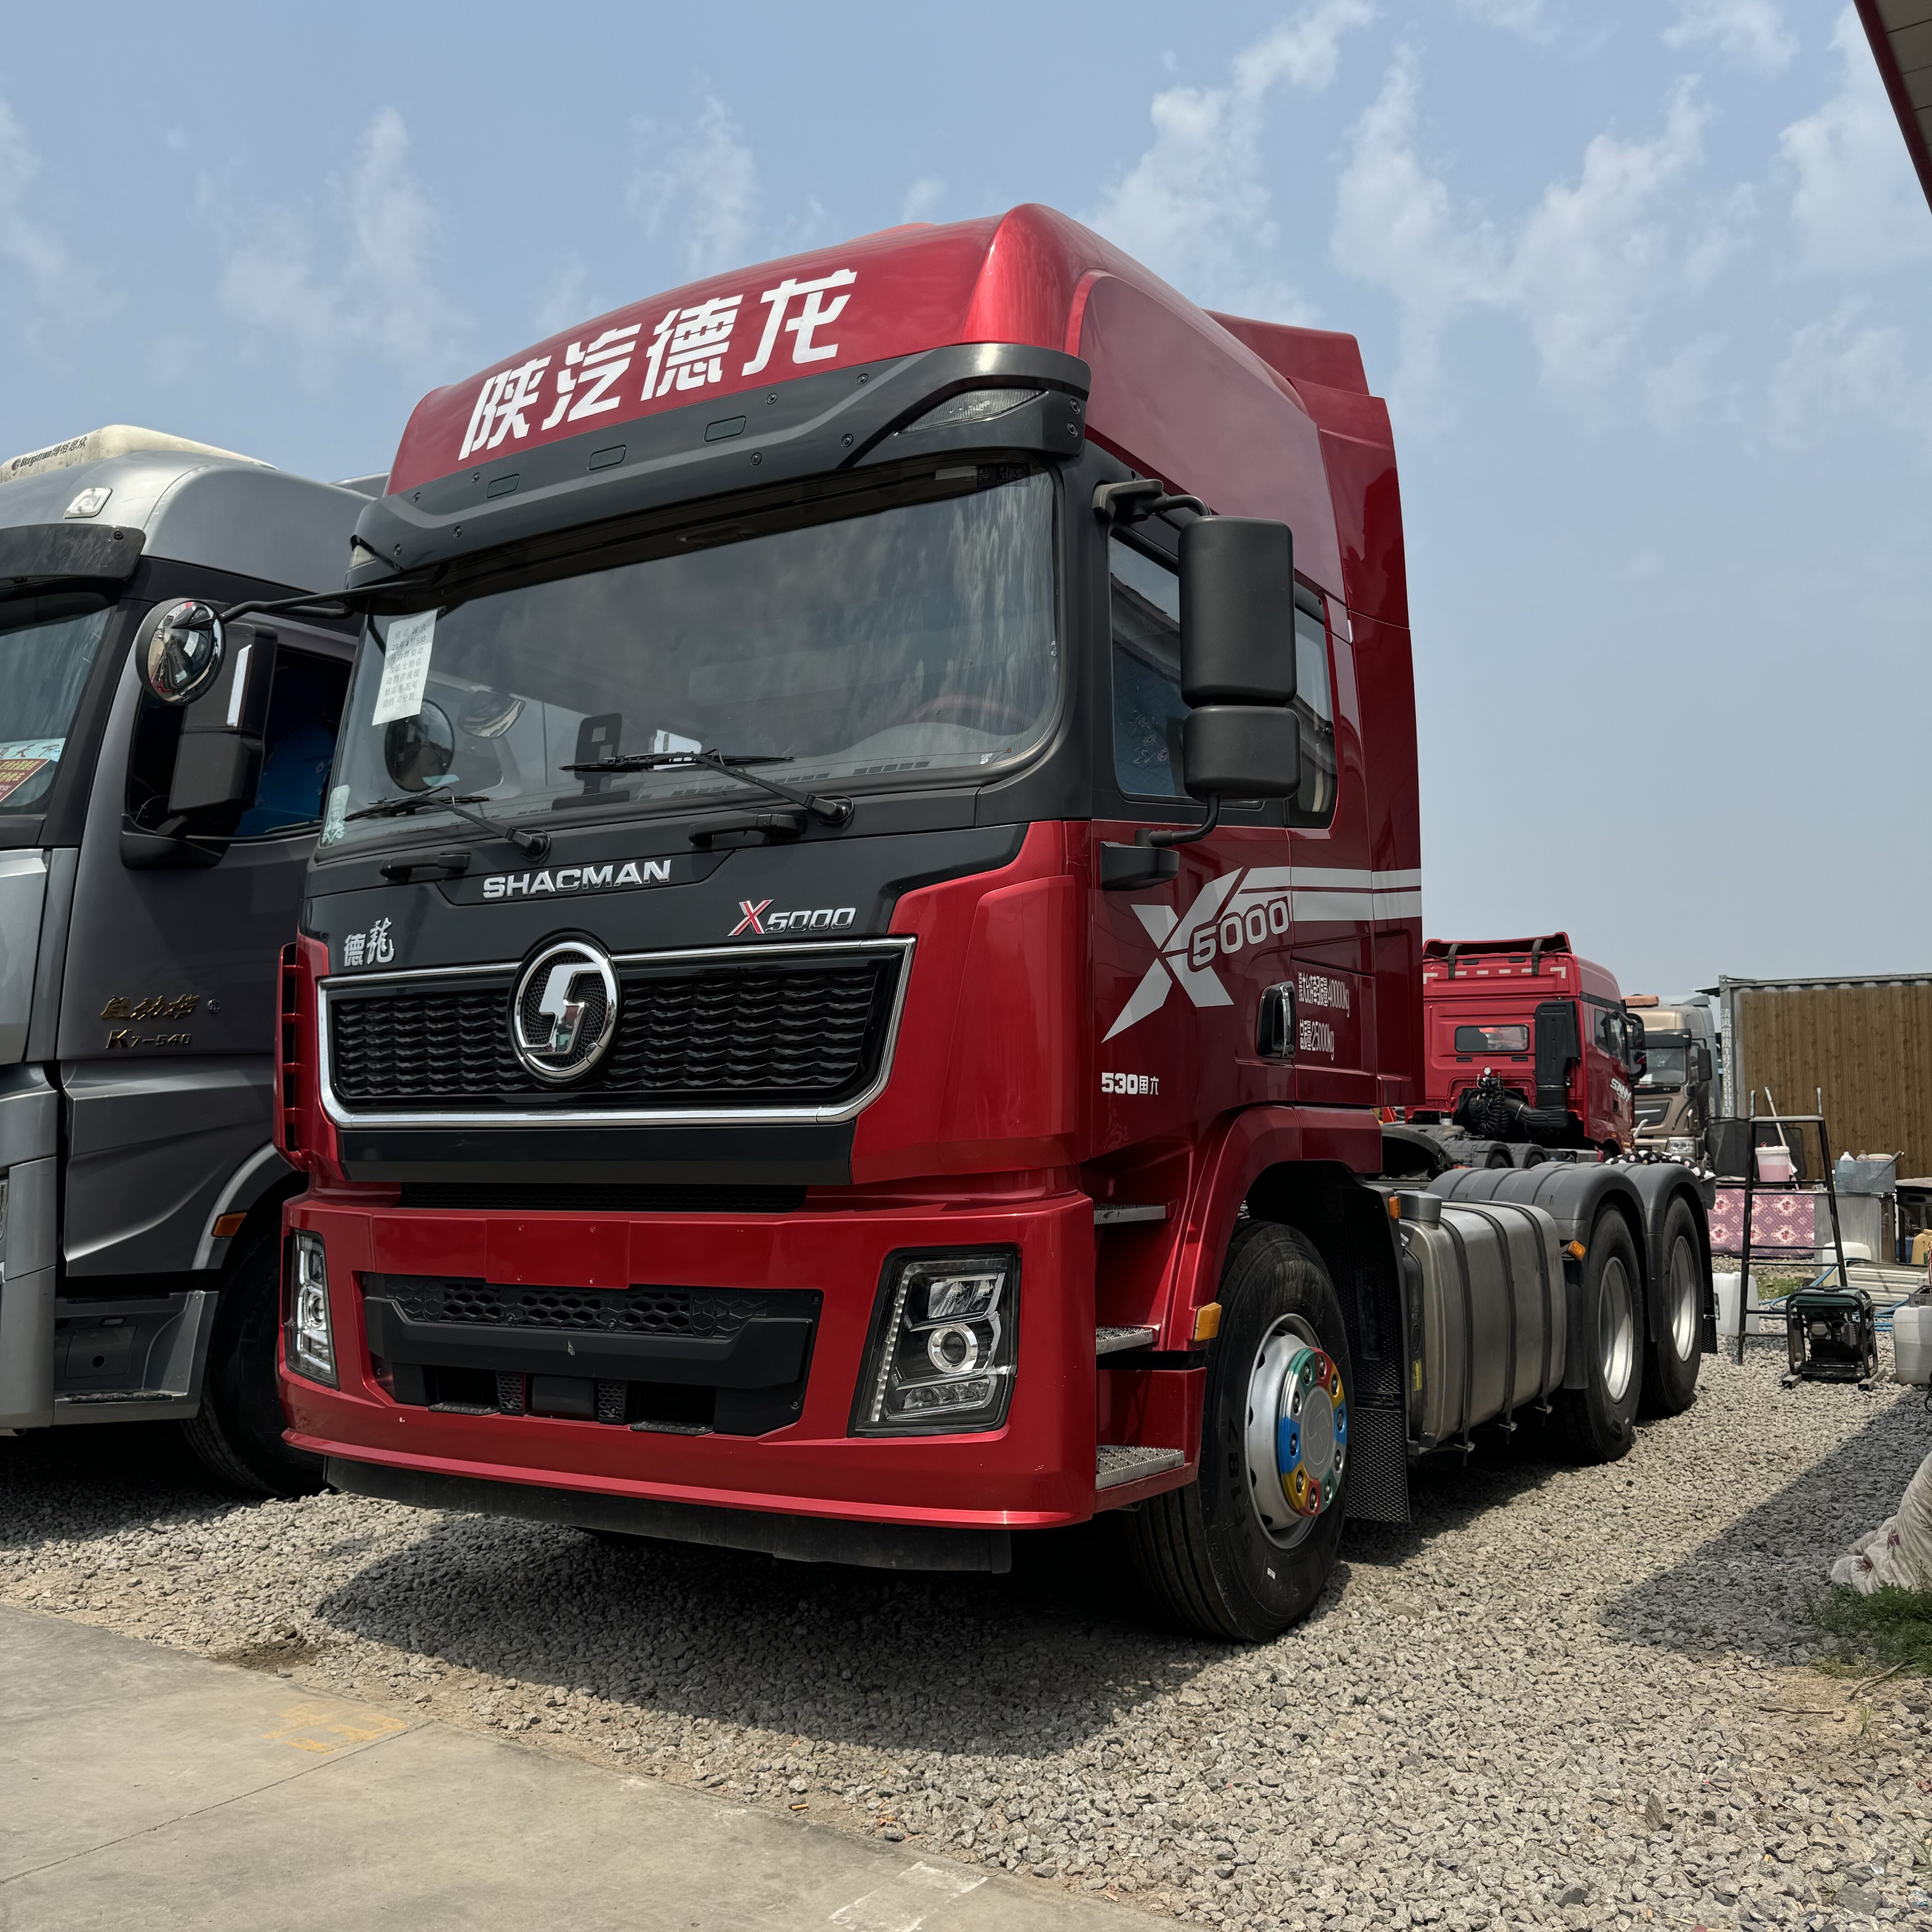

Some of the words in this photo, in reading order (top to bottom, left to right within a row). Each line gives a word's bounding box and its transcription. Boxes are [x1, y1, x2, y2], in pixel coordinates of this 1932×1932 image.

[458, 268, 858, 460] 陕汽德龙
[483, 859, 671, 898] SHACMAN
[727, 899, 856, 936] X5000
[1102, 867, 1290, 1044] X5000
[105, 1029, 191, 1049] K7-540
[1101, 1072, 1159, 1095] 530国六
[1610, 1078, 1632, 1102] SANY
